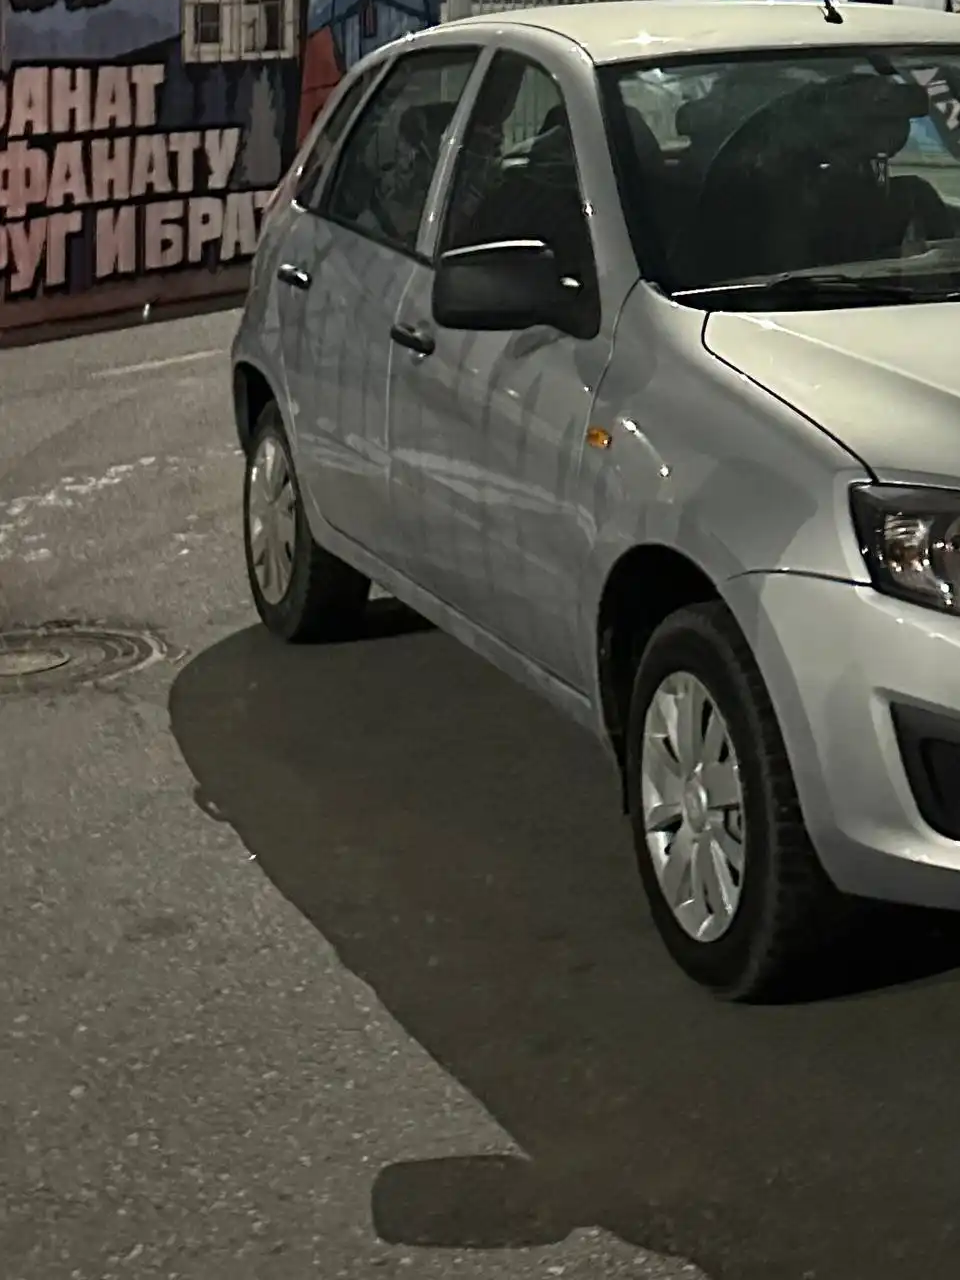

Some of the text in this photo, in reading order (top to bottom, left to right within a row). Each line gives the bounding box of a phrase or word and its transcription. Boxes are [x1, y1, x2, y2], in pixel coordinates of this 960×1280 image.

[0, 65, 164, 136] АНАТ
[0, 128, 241, 217] ФАНАТУ
[0, 212, 83, 292] УГ
[96, 204, 136, 278] И
